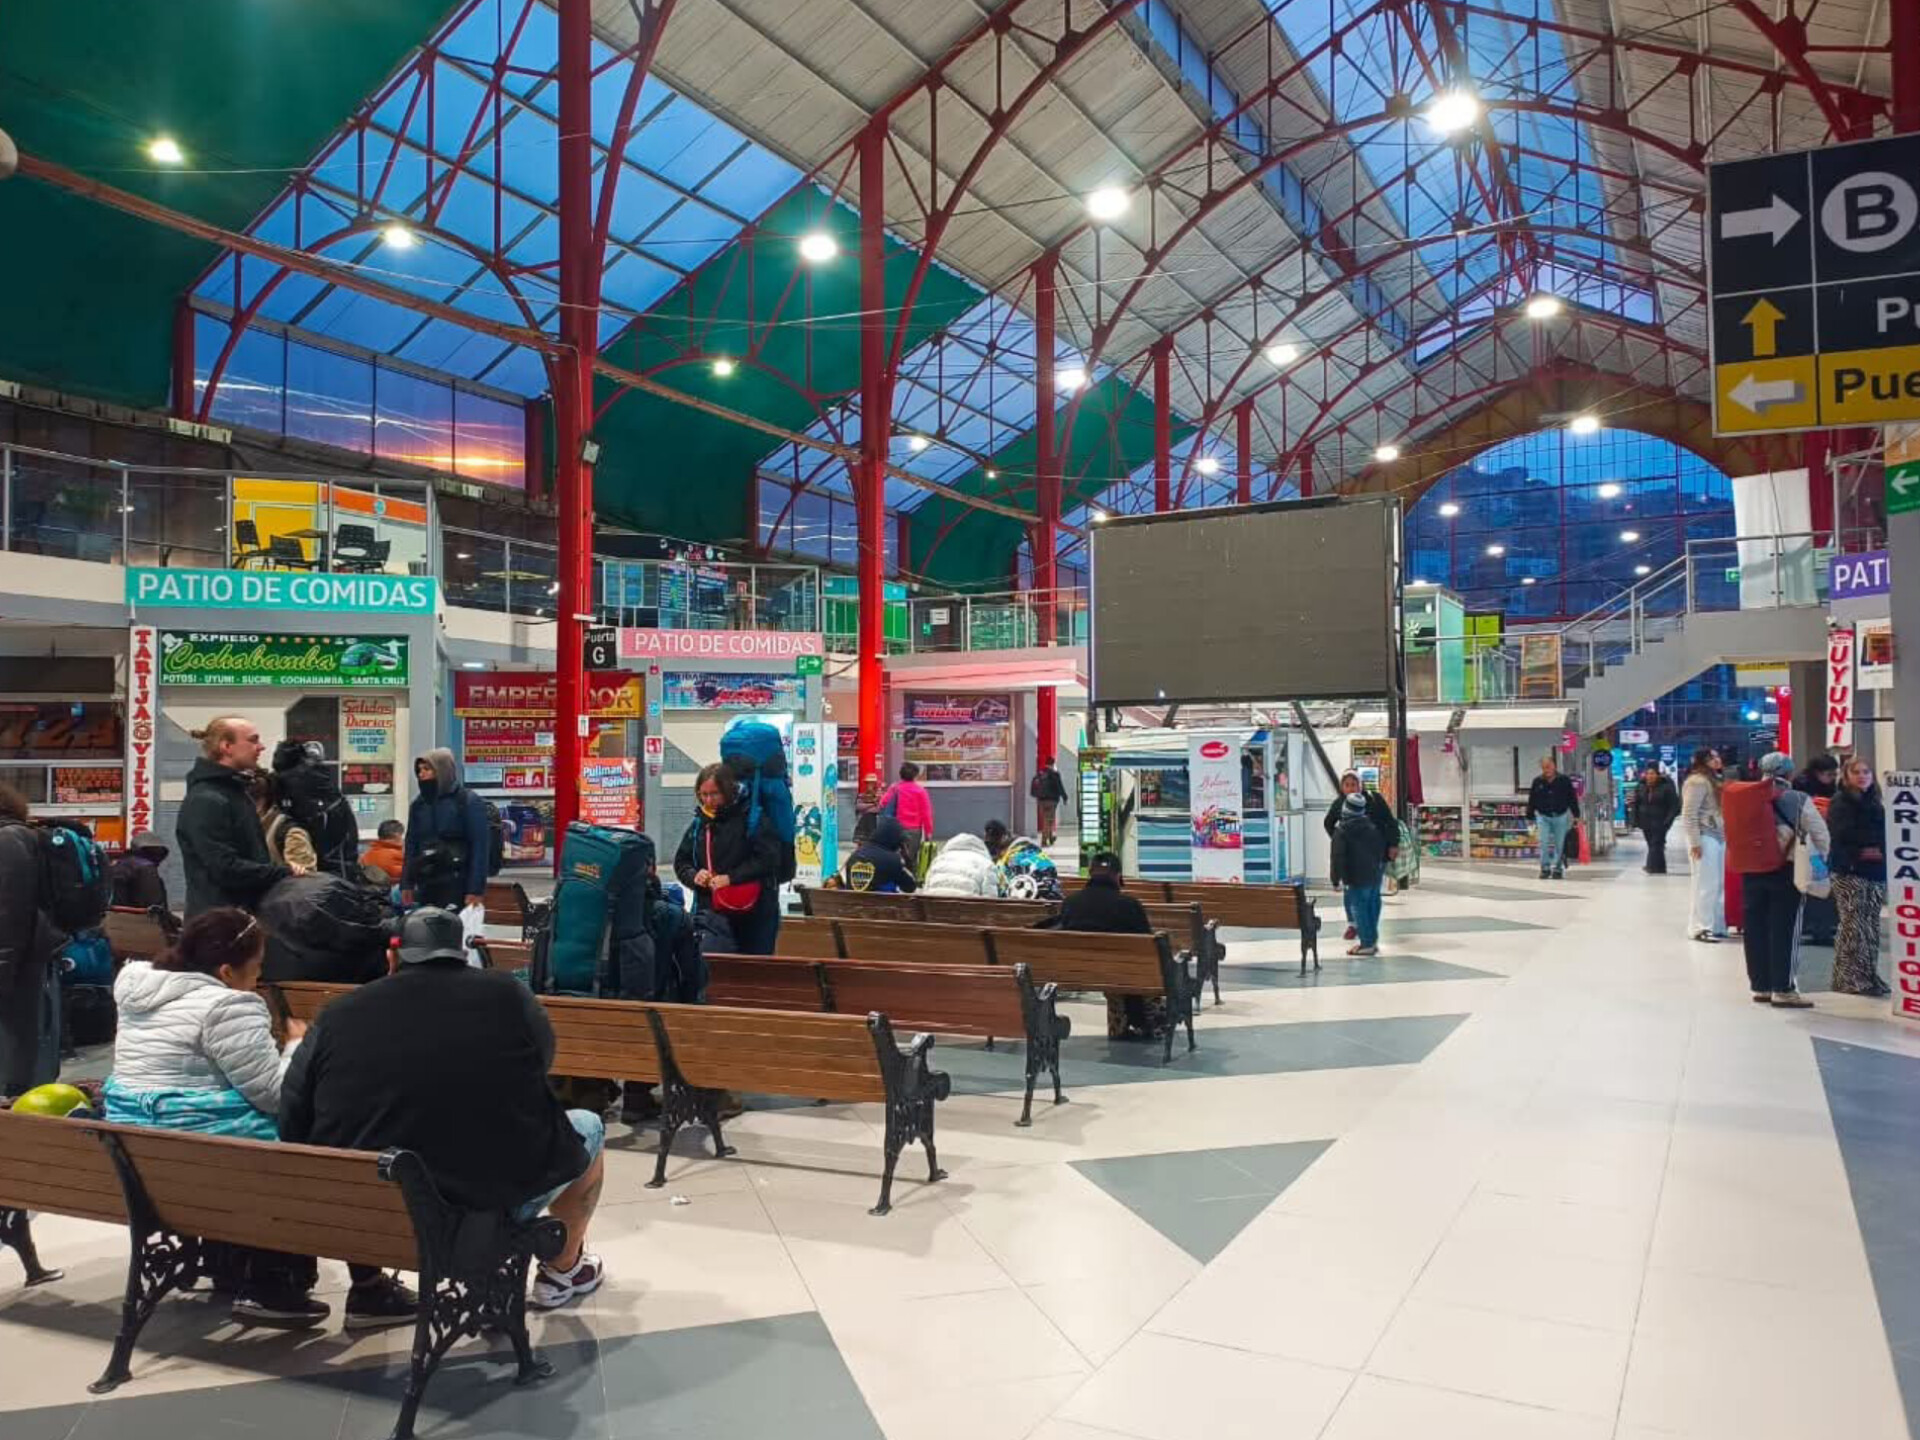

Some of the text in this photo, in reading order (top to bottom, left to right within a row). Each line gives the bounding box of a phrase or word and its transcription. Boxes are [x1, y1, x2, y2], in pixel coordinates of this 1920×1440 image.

[1844, 184, 1899, 240] B
[1877, 296, 1920, 333] P
[1834, 368, 1920, 404] Pue
[138, 573, 427, 608] PATIO DE COMIDAS
[189, 633, 260, 643] EXPRESO
[583, 632, 615, 643] Puerta
[635, 633, 815, 654] PATIO DE COMIDAS
[164, 641, 337, 674] Cochabamba
[592, 647, 605, 664] G
[132, 629, 152, 721] TARIJA
[242, 675, 272, 685] SUCRE
[350, 676, 380, 685] SANTA
[469, 686, 634, 709] EMPEROR
[1827, 645, 1849, 744] UYUNI
[506, 775, 541, 786] CBA
[584, 764, 622, 778] Pullman
[602, 776, 634, 787] Bolivia
[1886, 776, 1911, 788] SALE
[1892, 791, 1920, 880] ARICA
